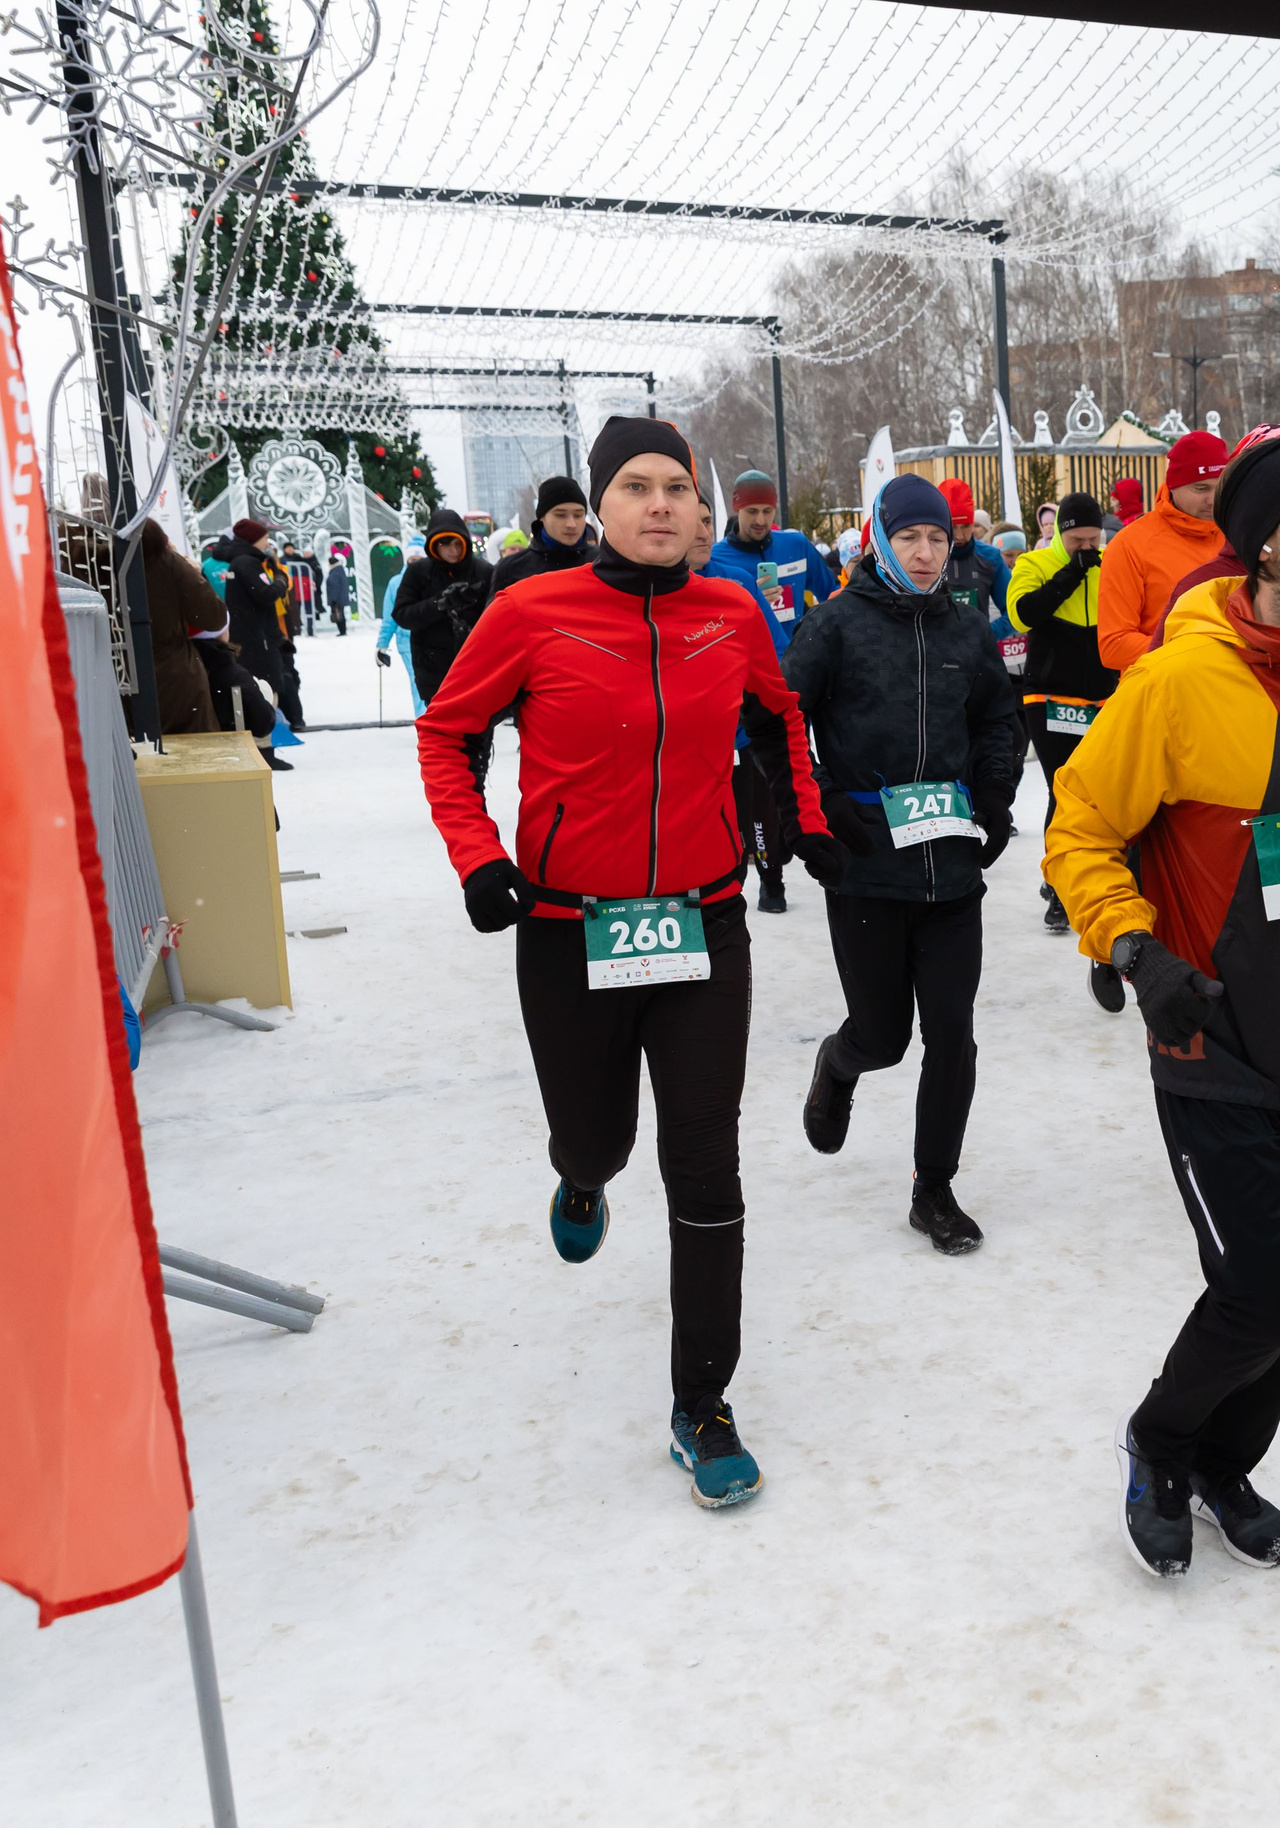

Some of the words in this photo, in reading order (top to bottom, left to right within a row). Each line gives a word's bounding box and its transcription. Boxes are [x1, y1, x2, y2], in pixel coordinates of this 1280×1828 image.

[1003, 642, 1025, 656] 509
[1056, 706, 1088, 723] 306
[903, 793, 952, 820] 247
[608, 906, 626, 914] РСХБ
[609, 917, 682, 954] 260
